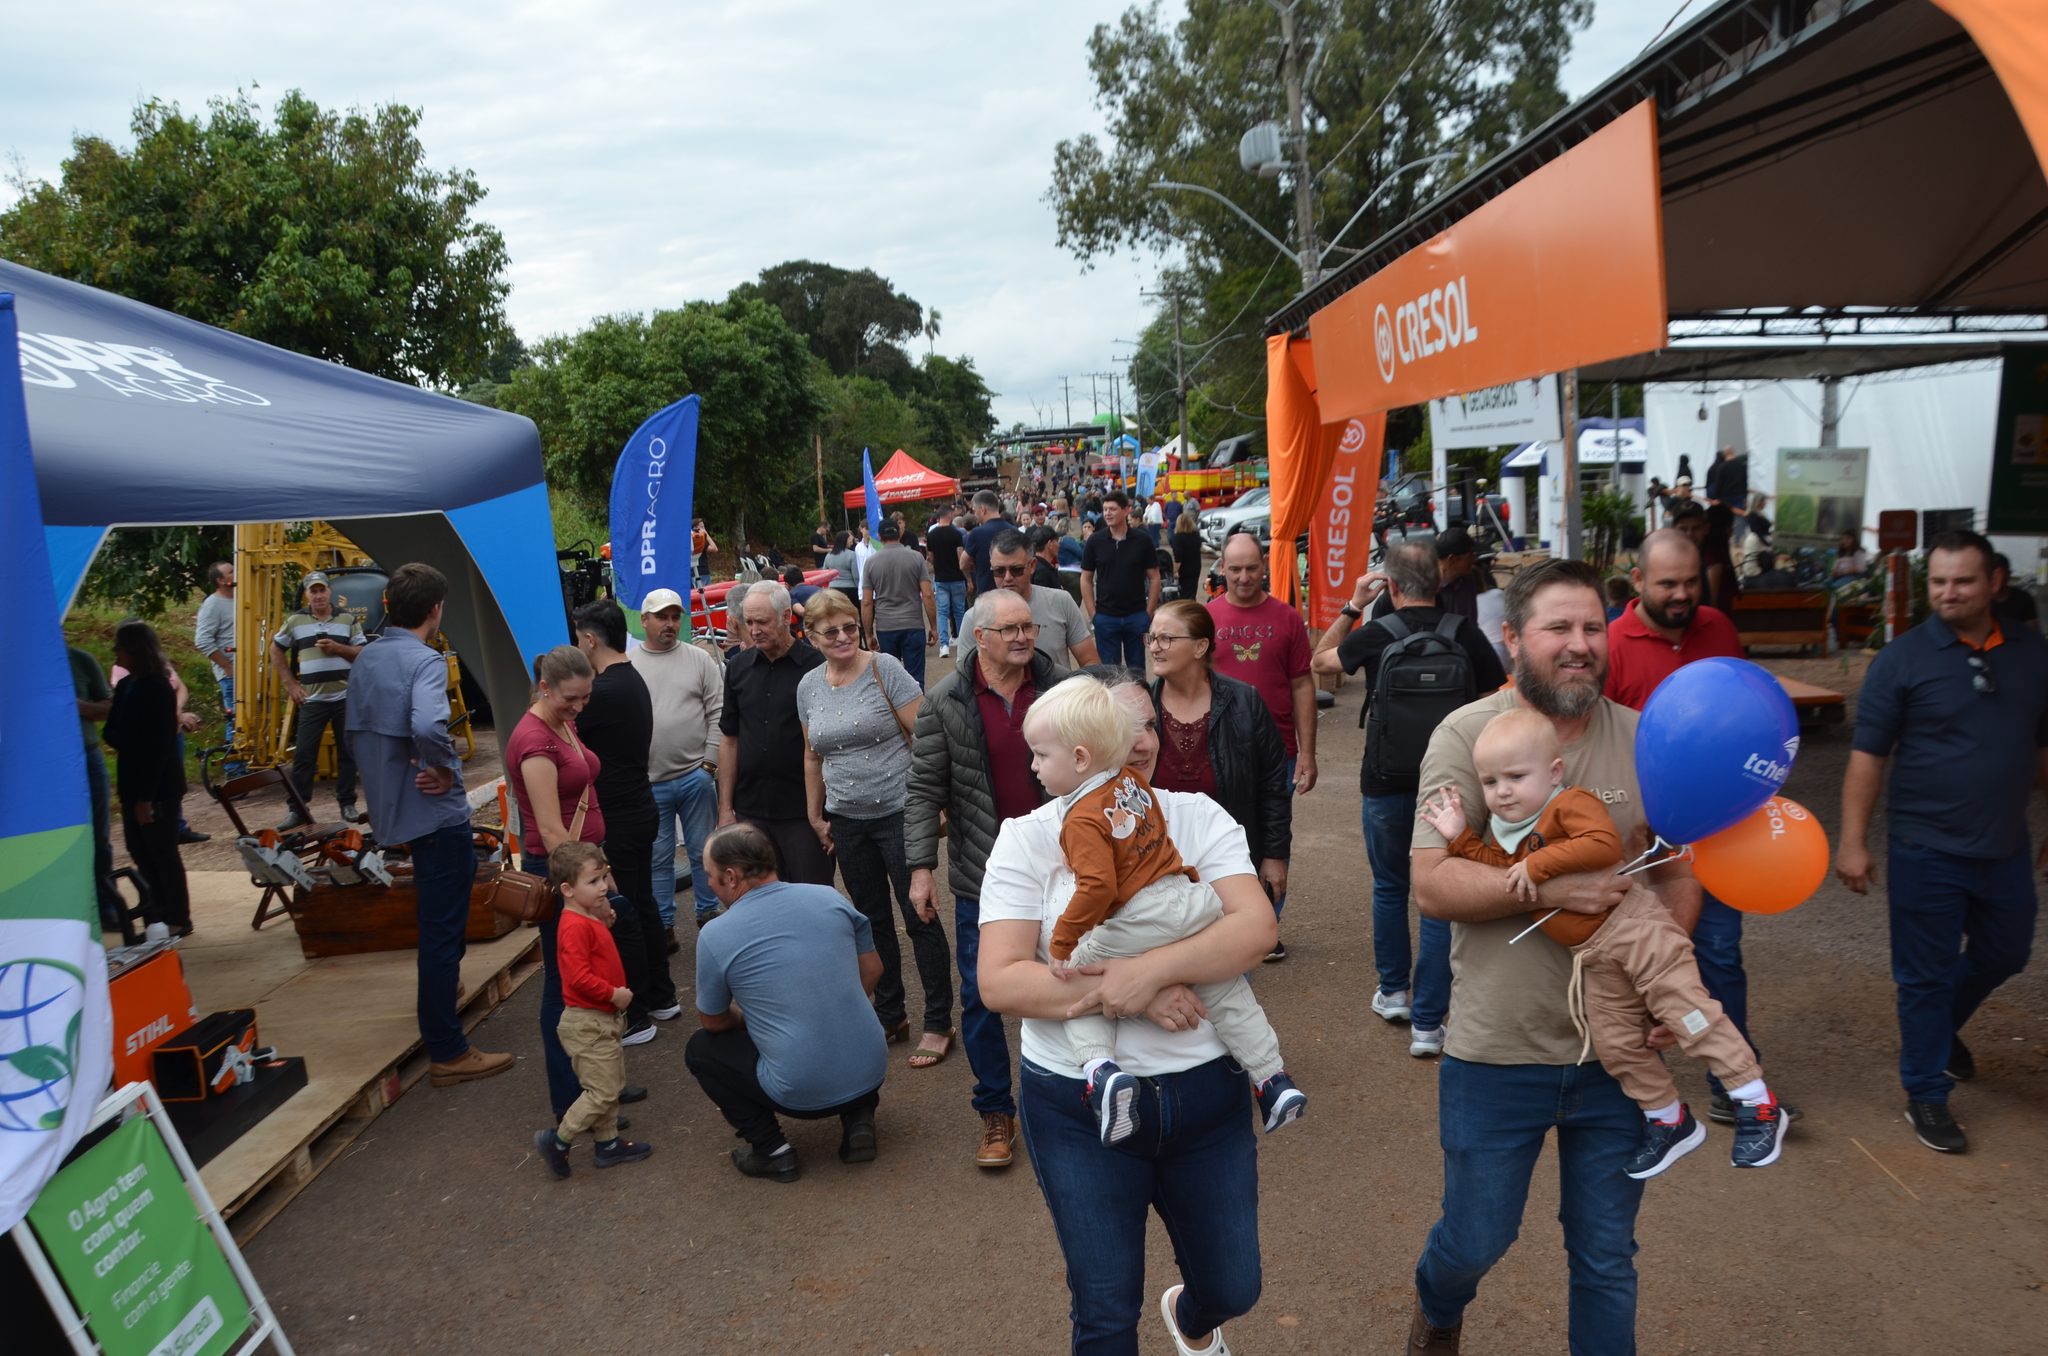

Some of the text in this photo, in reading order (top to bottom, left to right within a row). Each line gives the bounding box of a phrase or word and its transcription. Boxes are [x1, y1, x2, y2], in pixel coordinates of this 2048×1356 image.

[1396, 274, 1477, 364] CRESOL
[86, 371, 271, 406] AGRO
[1327, 466, 1356, 588] CRESOL
[1591, 786, 1629, 804] lein
[125, 1015, 175, 1057] STIHL
[68, 1163, 148, 1232] O Agro tem
[82, 1188, 154, 1255] com quem
[94, 1229, 146, 1278] contar.
[123, 1299, 151, 1330] com
